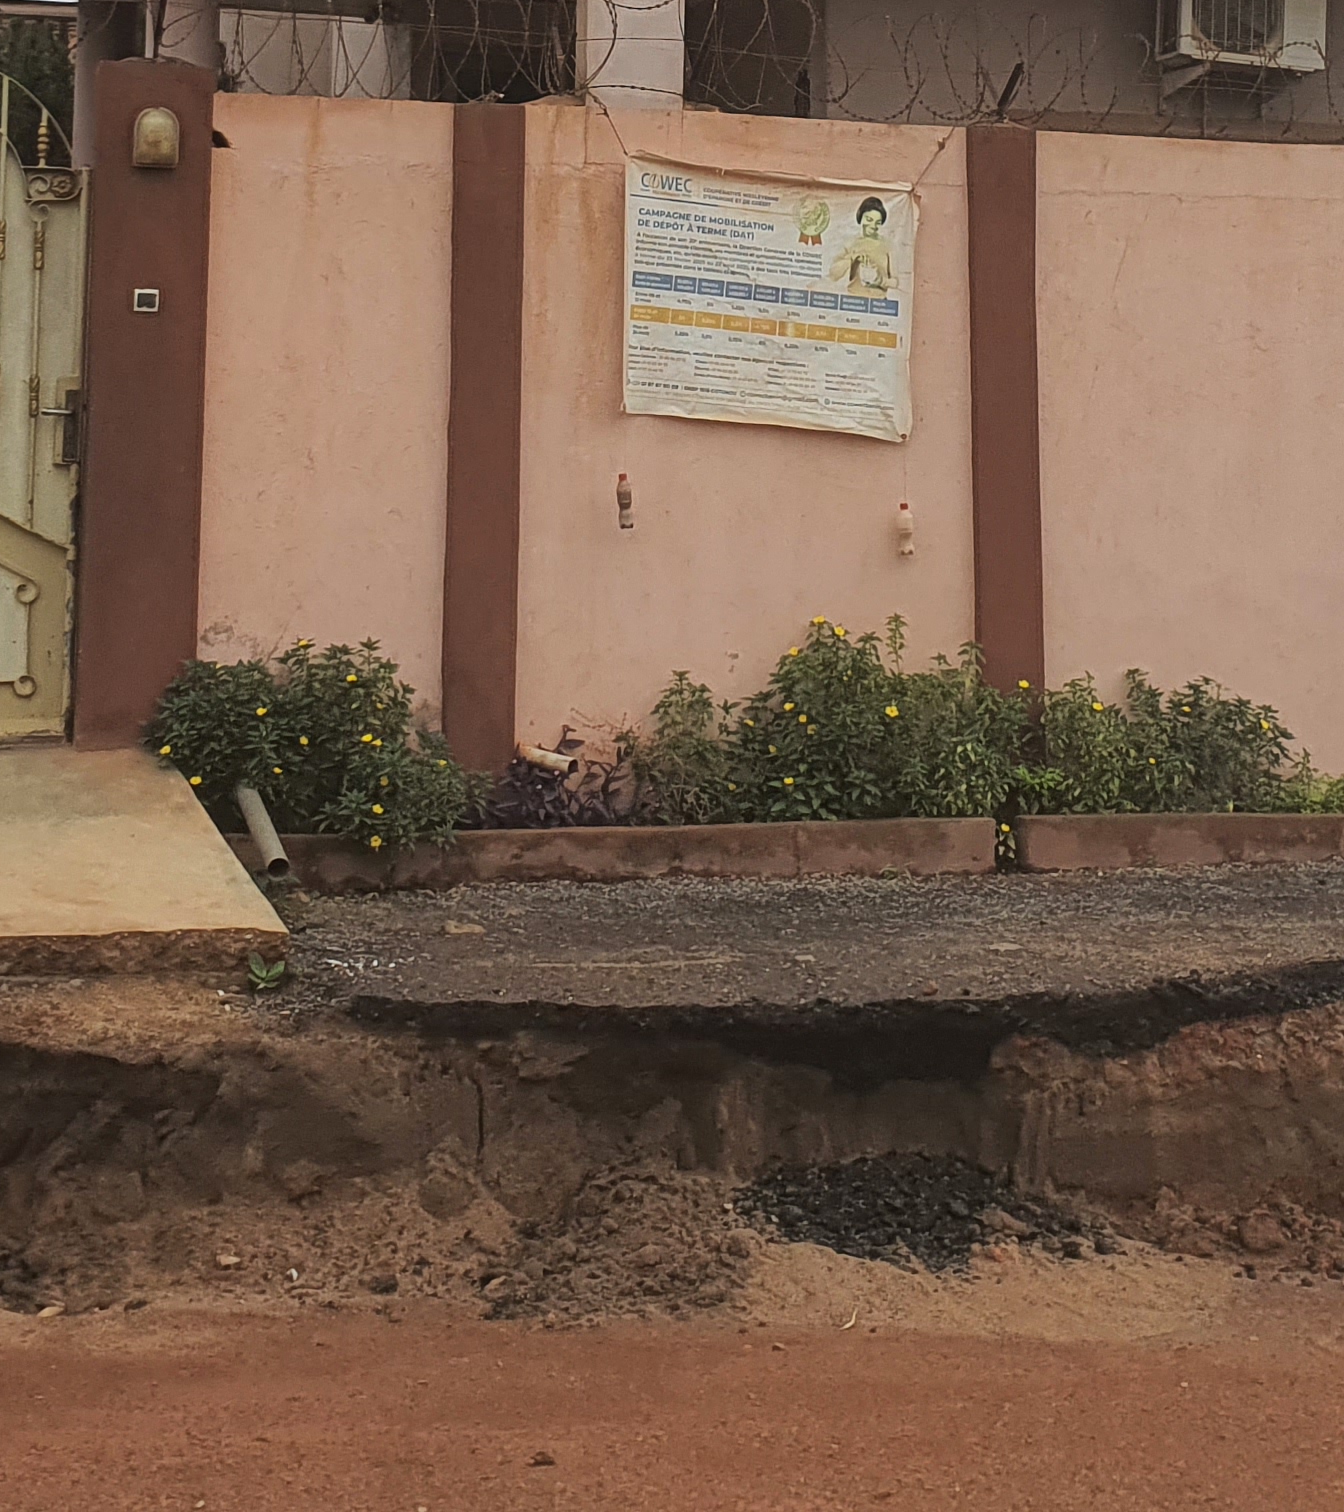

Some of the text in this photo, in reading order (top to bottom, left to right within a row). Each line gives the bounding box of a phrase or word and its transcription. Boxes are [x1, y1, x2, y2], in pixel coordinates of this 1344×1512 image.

[638, 207, 774, 232] CAMPAGNE DE MOBILISATION
[638, 218, 651, 228] DE
[653, 219, 684, 232] DÉPÔT
[696, 226, 727, 237] TERME
[730, 229, 755, 241] (DAT)
